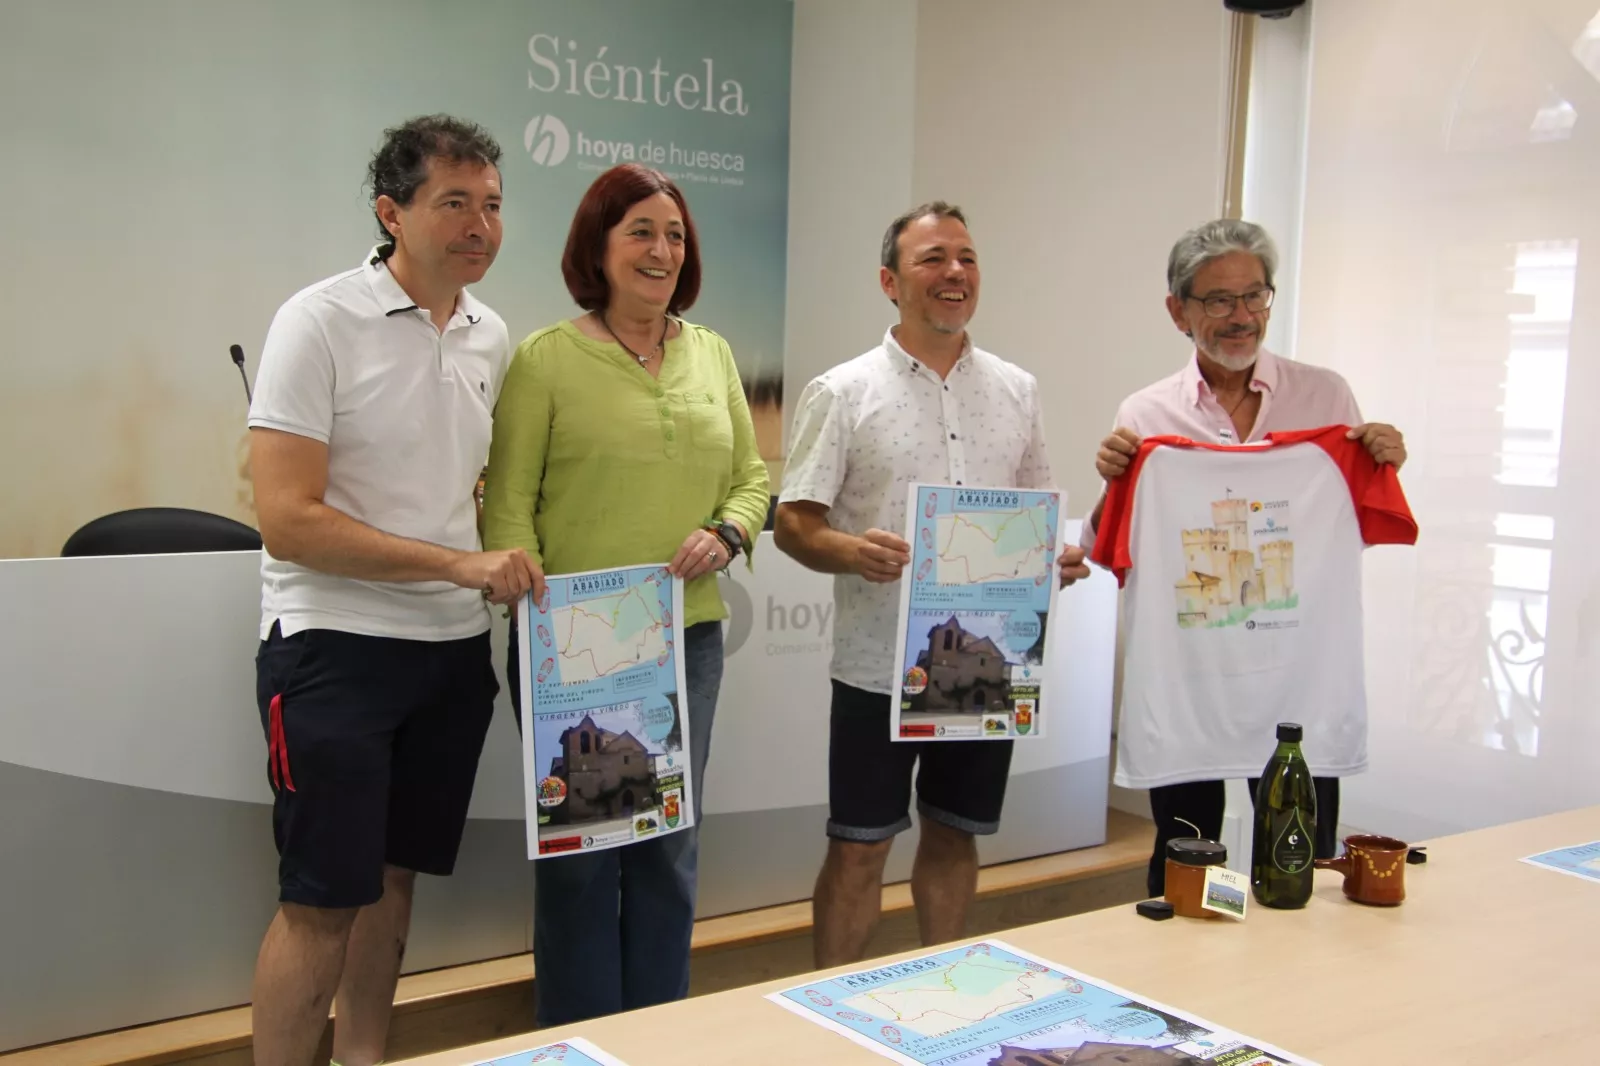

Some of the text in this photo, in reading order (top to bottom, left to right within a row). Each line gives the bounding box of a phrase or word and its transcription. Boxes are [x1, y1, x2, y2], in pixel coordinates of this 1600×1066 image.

[528, 33, 749, 117] Siéntela
[577, 131, 745, 172] hoya de huesca
[958, 495, 1019, 505] ABADIADO
[573, 578, 624, 591] ABADIADO
[766, 595, 833, 637] hoy
[539, 712, 575, 721] VIRGEN
[846, 961, 937, 986] ABADIADO
[913, 1041, 946, 1054] VIRGEN
[948, 1034, 966, 1043] DEL
[935, 1047, 985, 1066] VIRGEN
[1016, 1024, 1062, 1042] VIÑEDO
